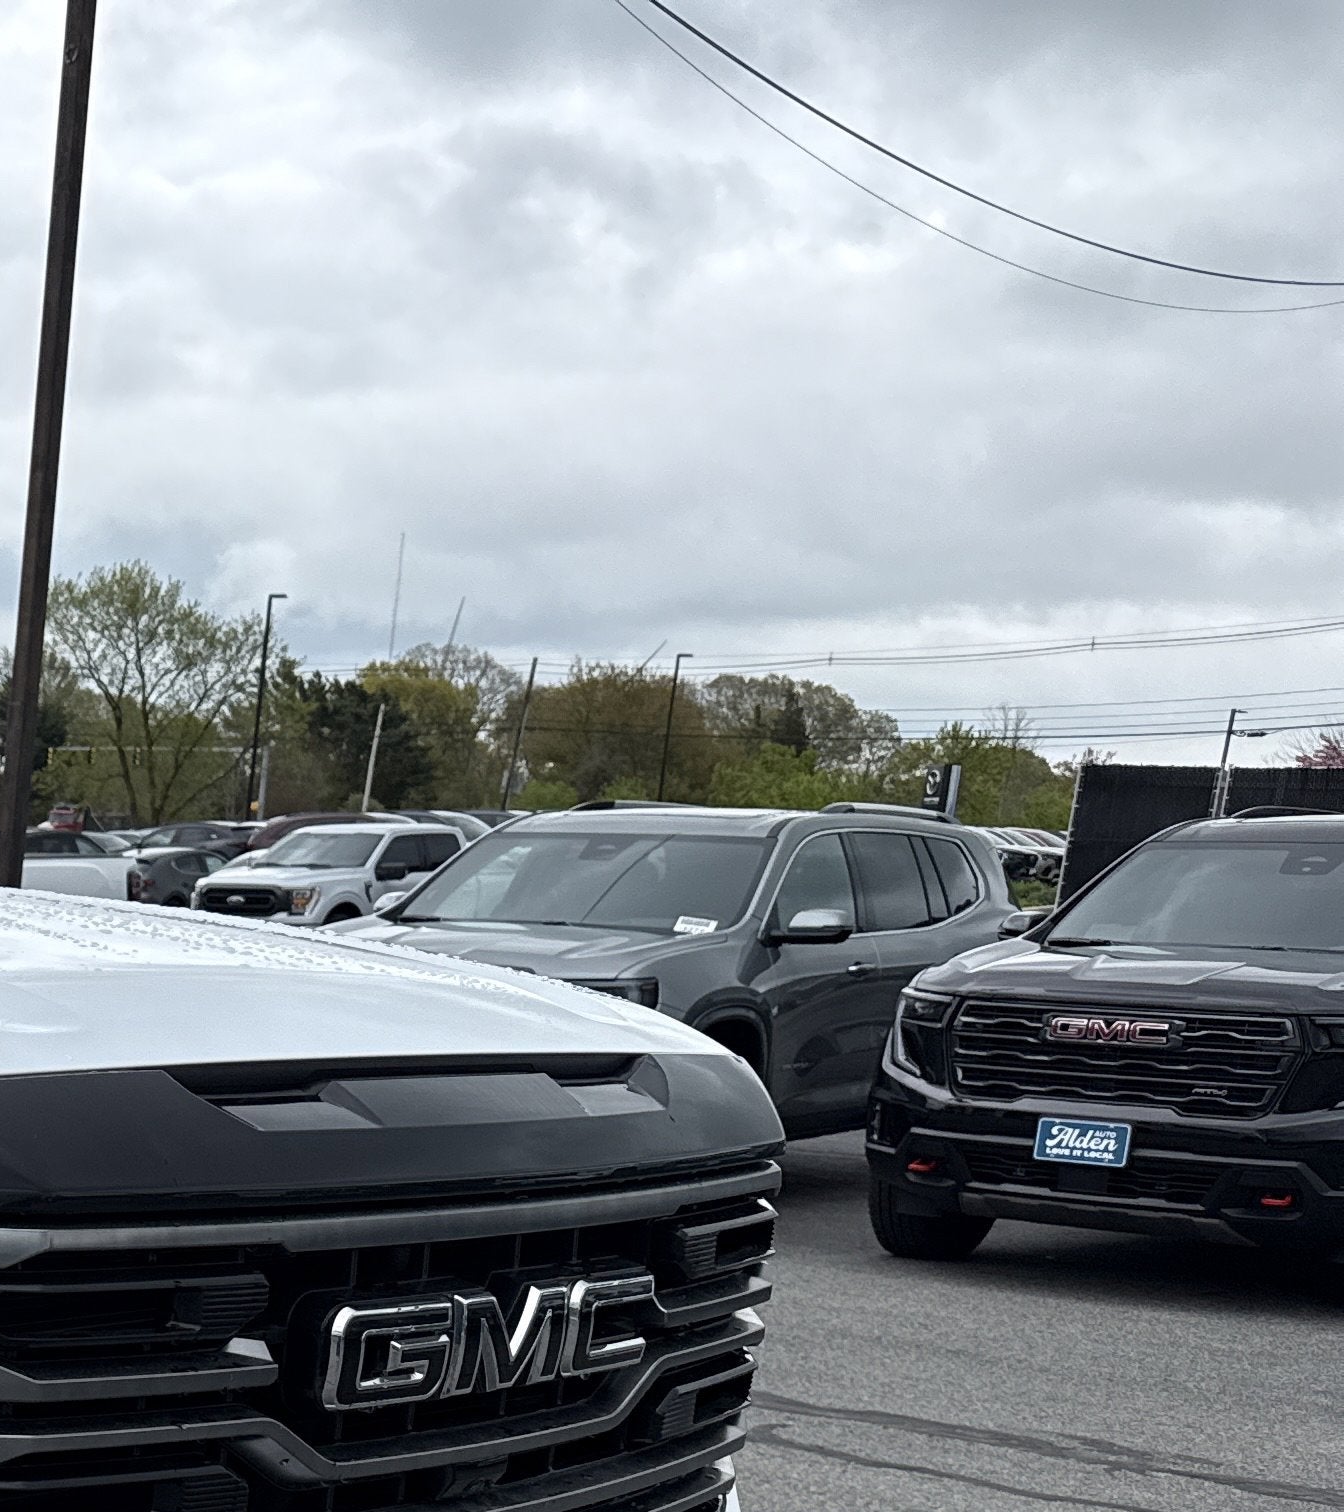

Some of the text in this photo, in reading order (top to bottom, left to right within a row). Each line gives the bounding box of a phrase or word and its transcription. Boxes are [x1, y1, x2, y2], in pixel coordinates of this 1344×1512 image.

[1049, 1016, 1170, 1044] GMC
[1045, 1125, 1118, 1151] Alden
[1094, 1130, 1117, 1139] AUTO
[1045, 1147, 1115, 1160] LOVE IT LOCAL
[321, 1275, 654, 1412] GMC
